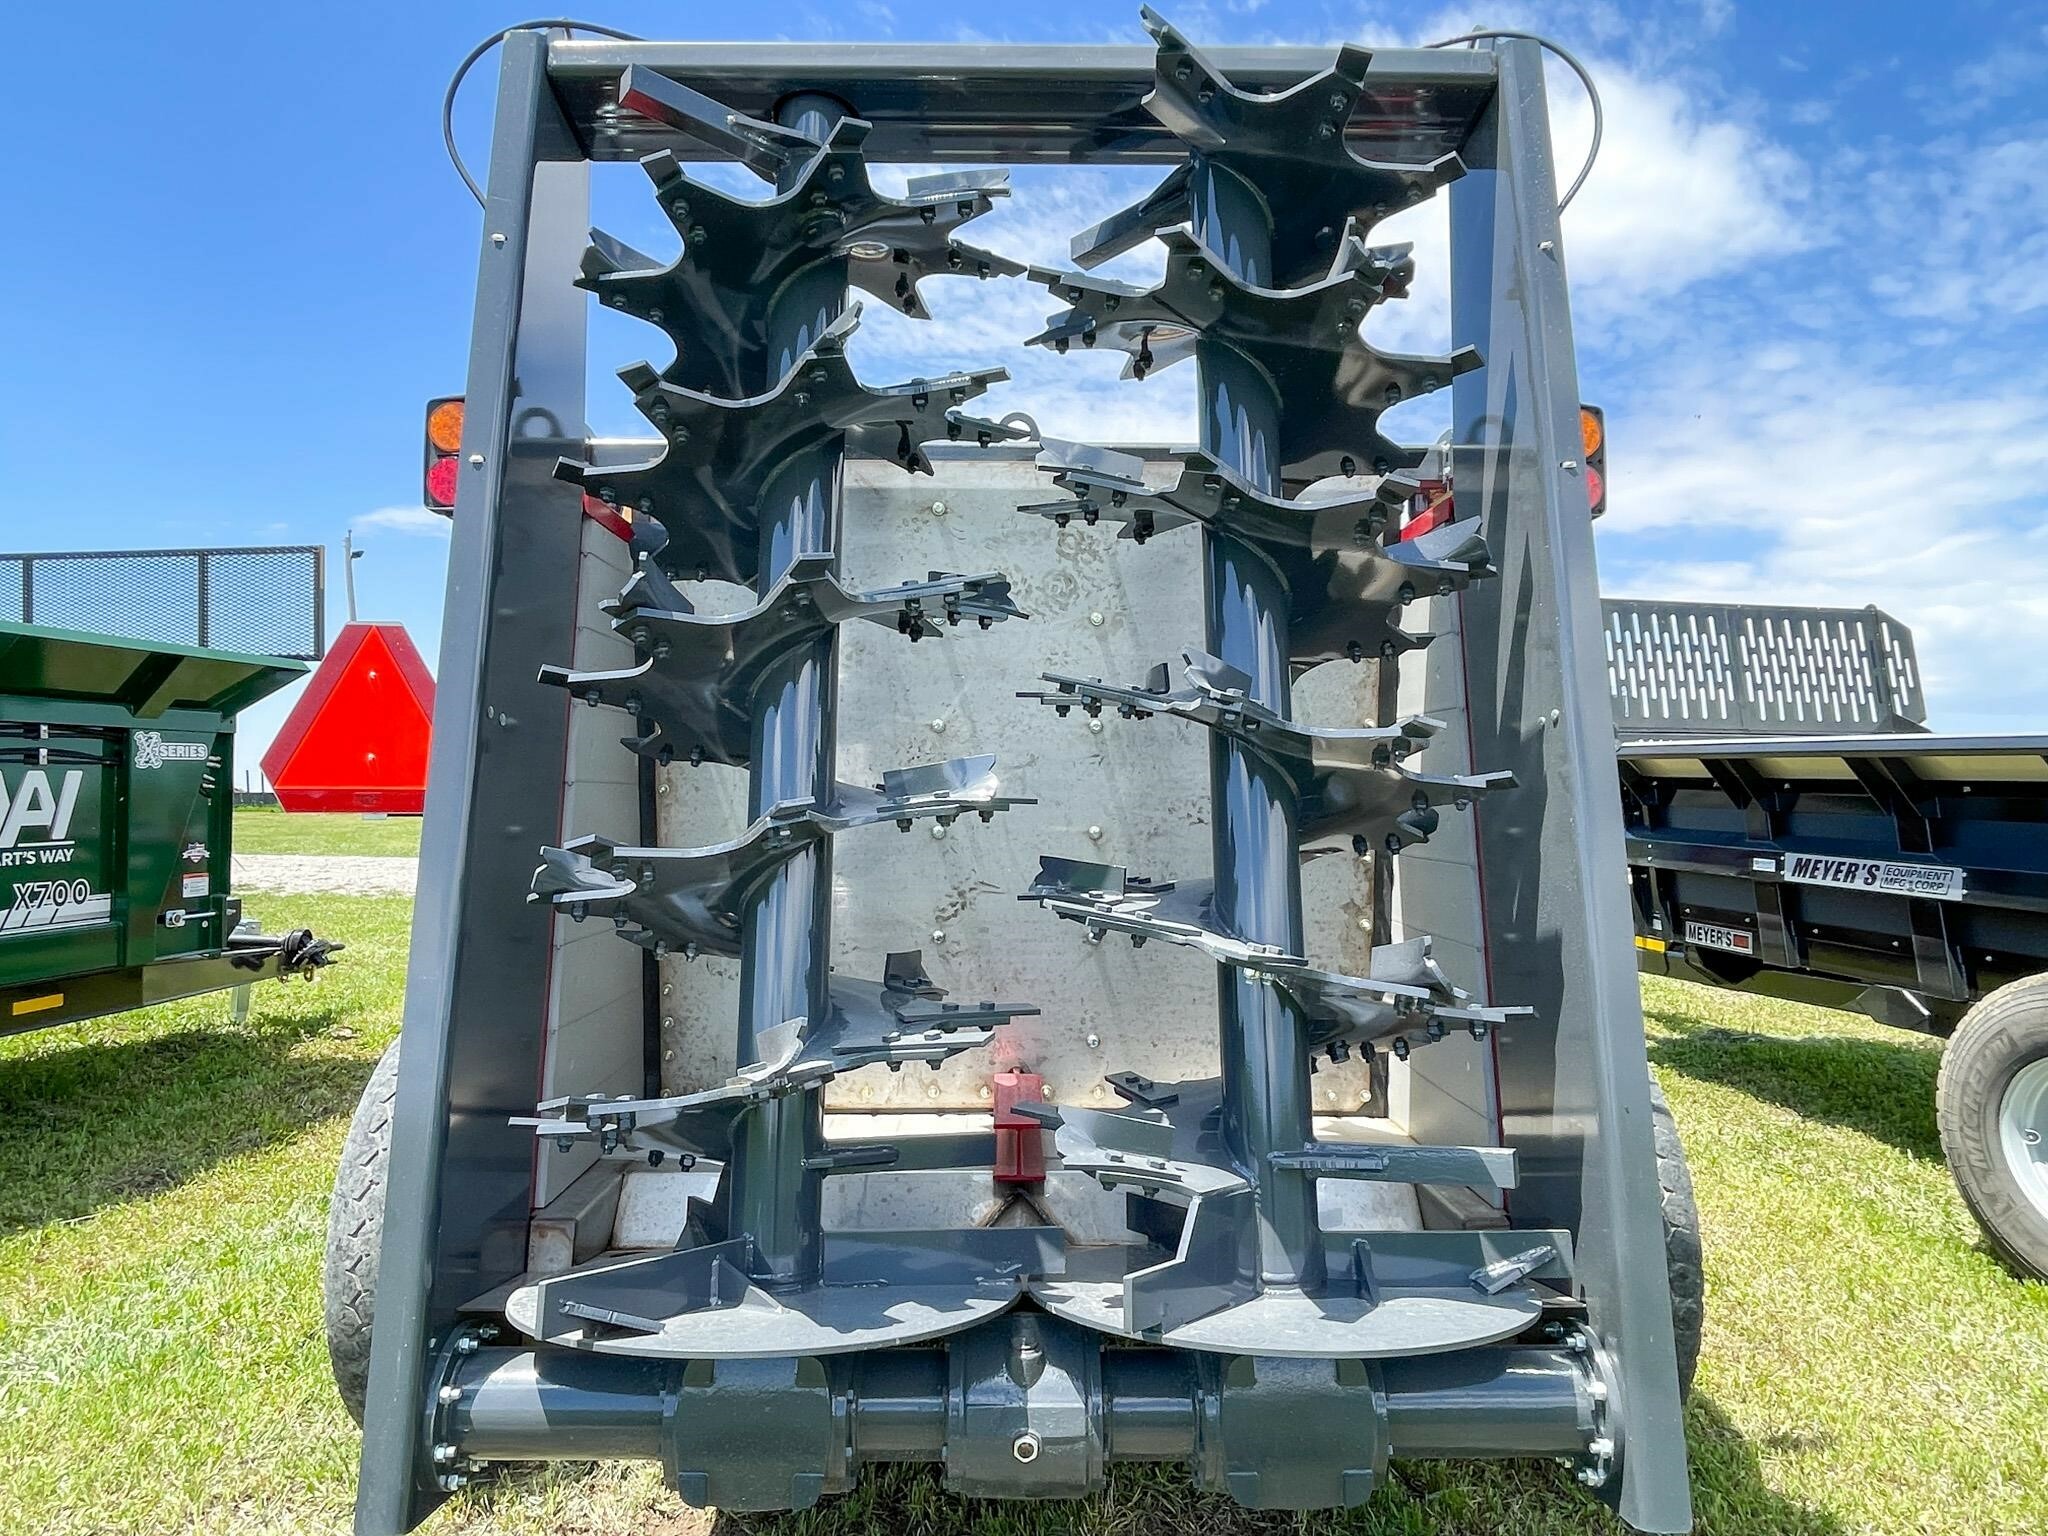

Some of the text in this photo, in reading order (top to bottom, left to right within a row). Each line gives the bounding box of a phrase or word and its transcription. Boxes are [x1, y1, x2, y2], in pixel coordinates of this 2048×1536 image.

[160, 745, 206, 758] SERIES
[0, 848, 75, 867] RT'S WAY
[1791, 857, 1880, 886] MEYER'S
[1885, 867, 1950, 882] EQUIPMENT
[1882, 877, 1945, 892] MFG CORP
[13, 878, 91, 912] X700
[1688, 924, 1732, 947] MEYER'S
